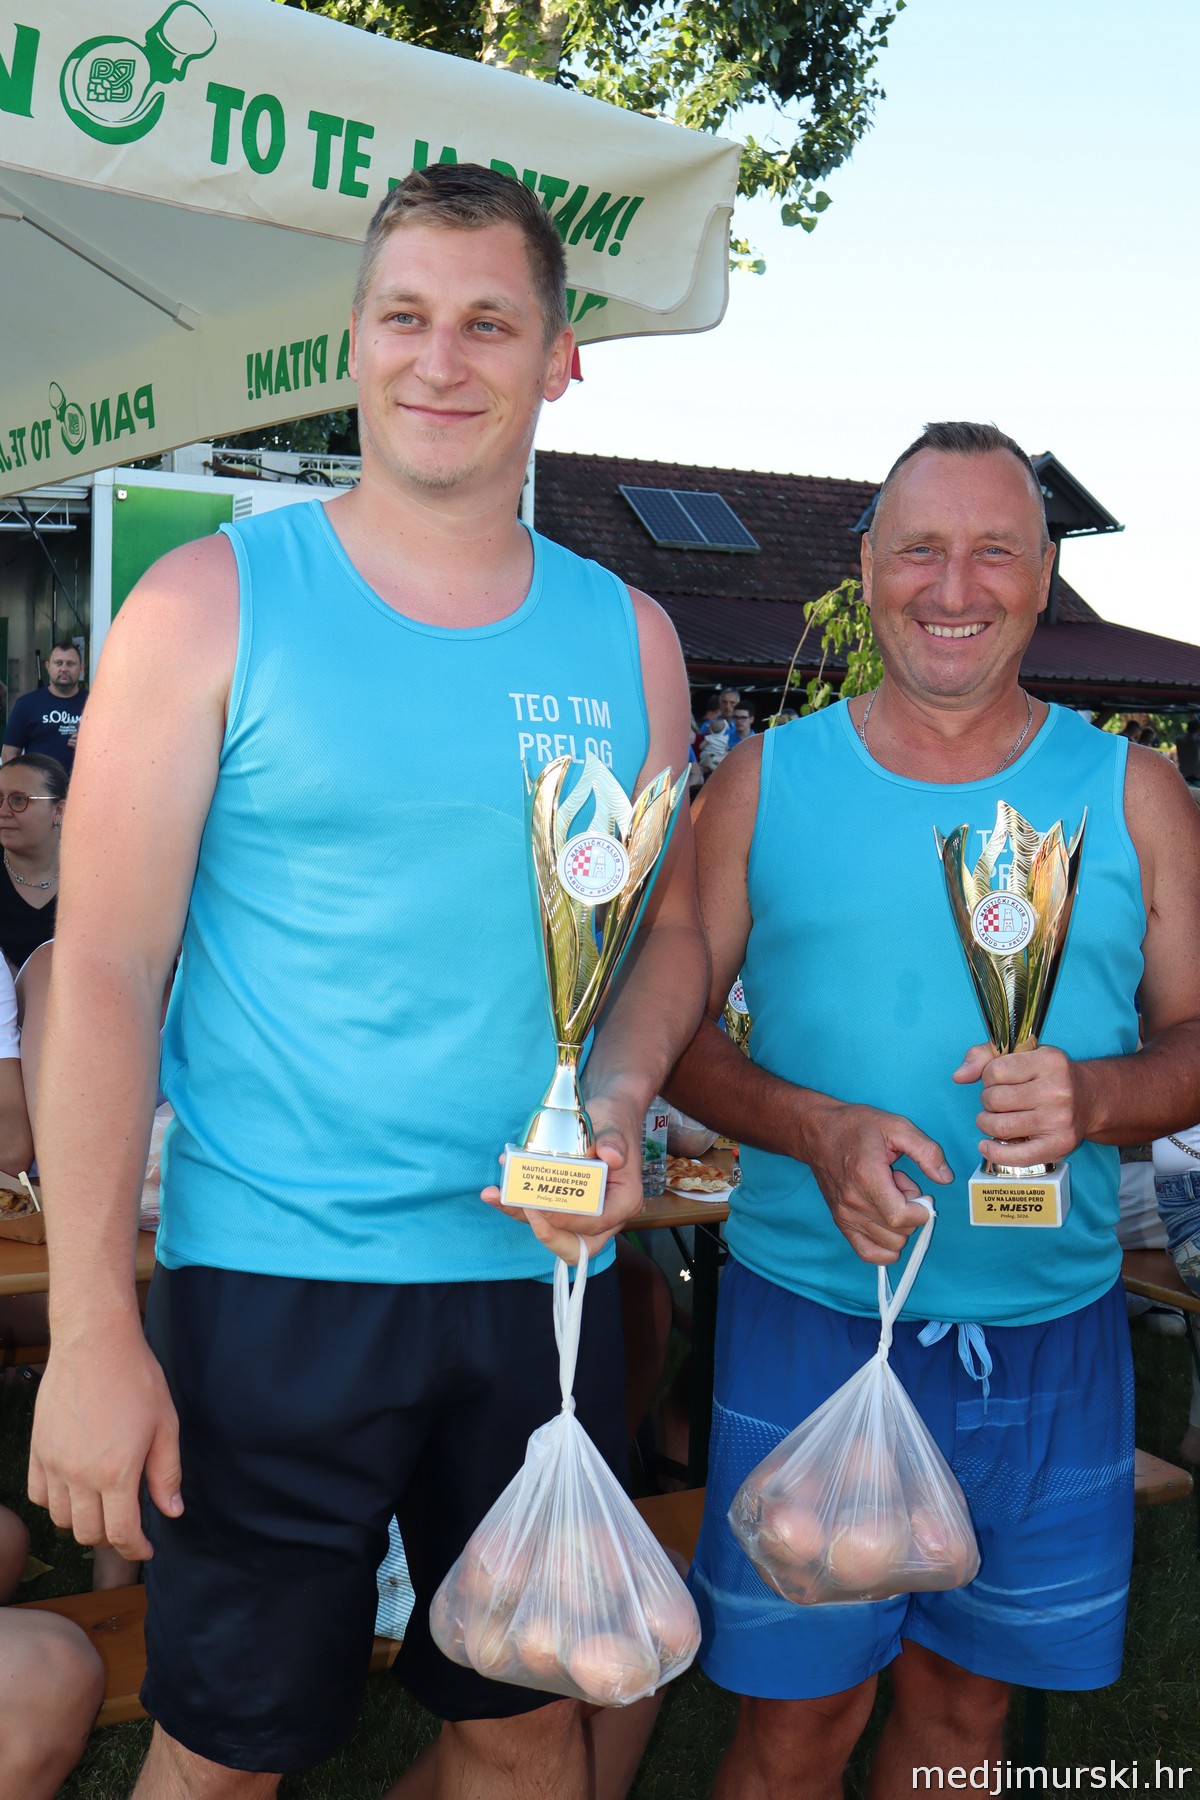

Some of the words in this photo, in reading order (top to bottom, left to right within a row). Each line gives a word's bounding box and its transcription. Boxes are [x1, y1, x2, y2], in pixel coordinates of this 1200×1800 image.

[206, 81, 286, 174] TO
[306, 110, 375, 198] TE
[490, 158, 645, 256] TAM!
[42, 710, 82, 724] s.Oliv
[508, 692, 560, 723] TEO
[567, 696, 612, 729] TIM
[606, 845, 620, 863] KLUB
[567, 870, 585, 892] LABUD
[1011, 901, 1026, 917] KLUB
[980, 928, 998, 947] LABUD
[521, 1165, 551, 1174] NAUTIČKI
[552, 1168, 569, 1177] KLUB
[569, 1170, 591, 1179] LABUD
[523, 1182, 534, 1191] 2.
[537, 1183, 585, 1197] MJESTO
[570, 1179, 588, 1187] PERO
[986, 1203, 997, 1212] 2.
[1000, 1203, 1043, 1212] MJESTO
